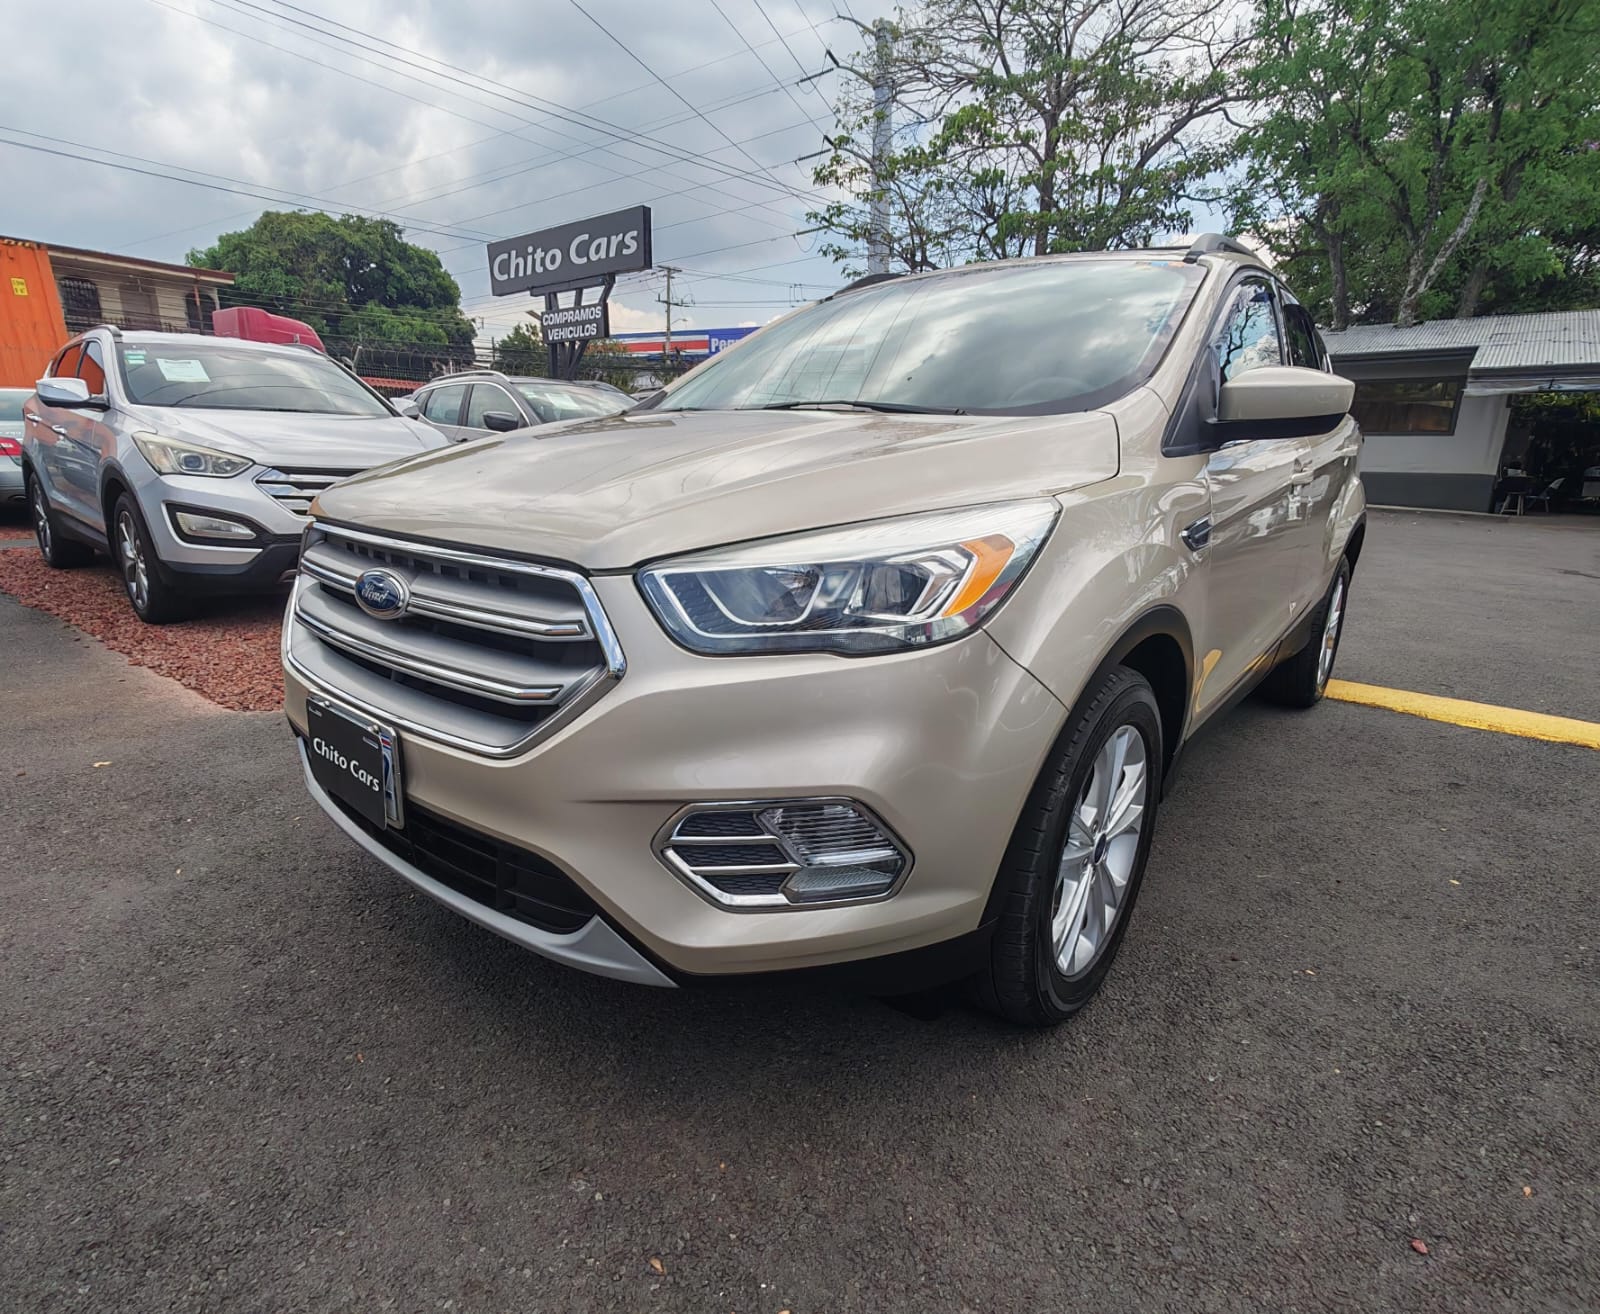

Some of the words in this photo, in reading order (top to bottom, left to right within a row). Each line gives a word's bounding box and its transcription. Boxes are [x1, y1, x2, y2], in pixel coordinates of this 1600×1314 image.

[493, 245, 562, 281] Chito
[569, 230, 638, 265] Cars
[542, 306, 602, 326] COMPRAMOS
[547, 323, 597, 341] VEHICULOS
[361, 581, 390, 603] Ford
[313, 737, 348, 769] Chito
[350, 760, 380, 792] Cars
